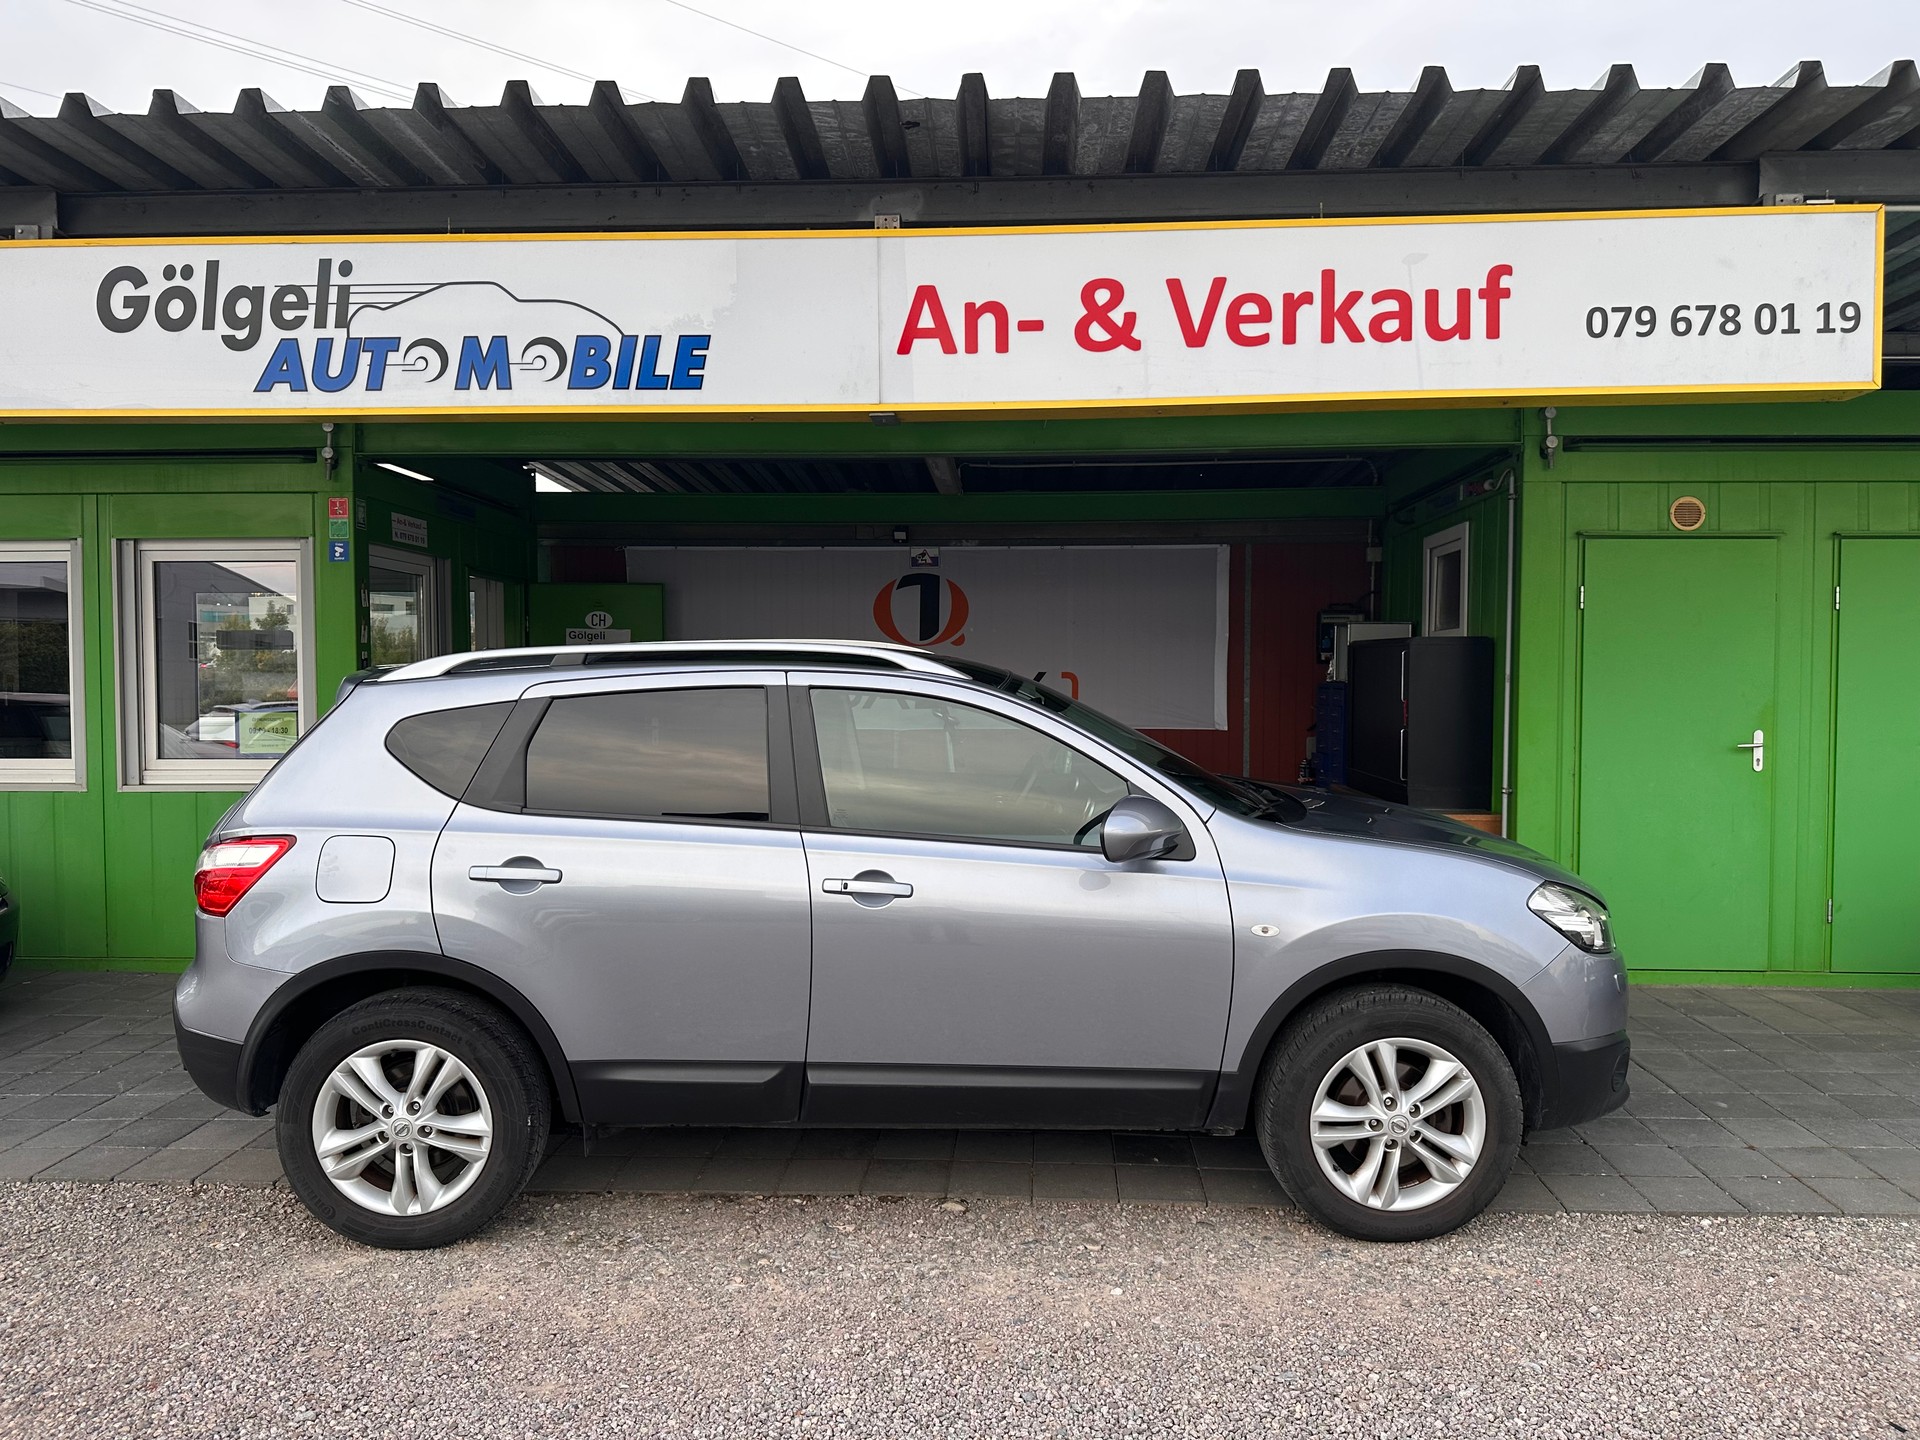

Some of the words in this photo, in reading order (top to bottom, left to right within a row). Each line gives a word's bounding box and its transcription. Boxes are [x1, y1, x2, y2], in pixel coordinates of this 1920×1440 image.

[96, 258, 353, 351] Gölgeli
[897, 284, 1044, 356] An-
[1074, 277, 1142, 353] &
[1166, 264, 1514, 349] Verkauf
[1585, 305, 1657, 338] 079
[1670, 303, 1742, 337] 678
[1754, 302, 1801, 335] 01
[1816, 301, 1862, 333] 19
[253, 334, 712, 393] AUTOMOBILE
[568, 630, 606, 642] Gölgeli
[591, 613, 606, 627] CH
[352, 1018, 463, 1044] ContiCrossContact
